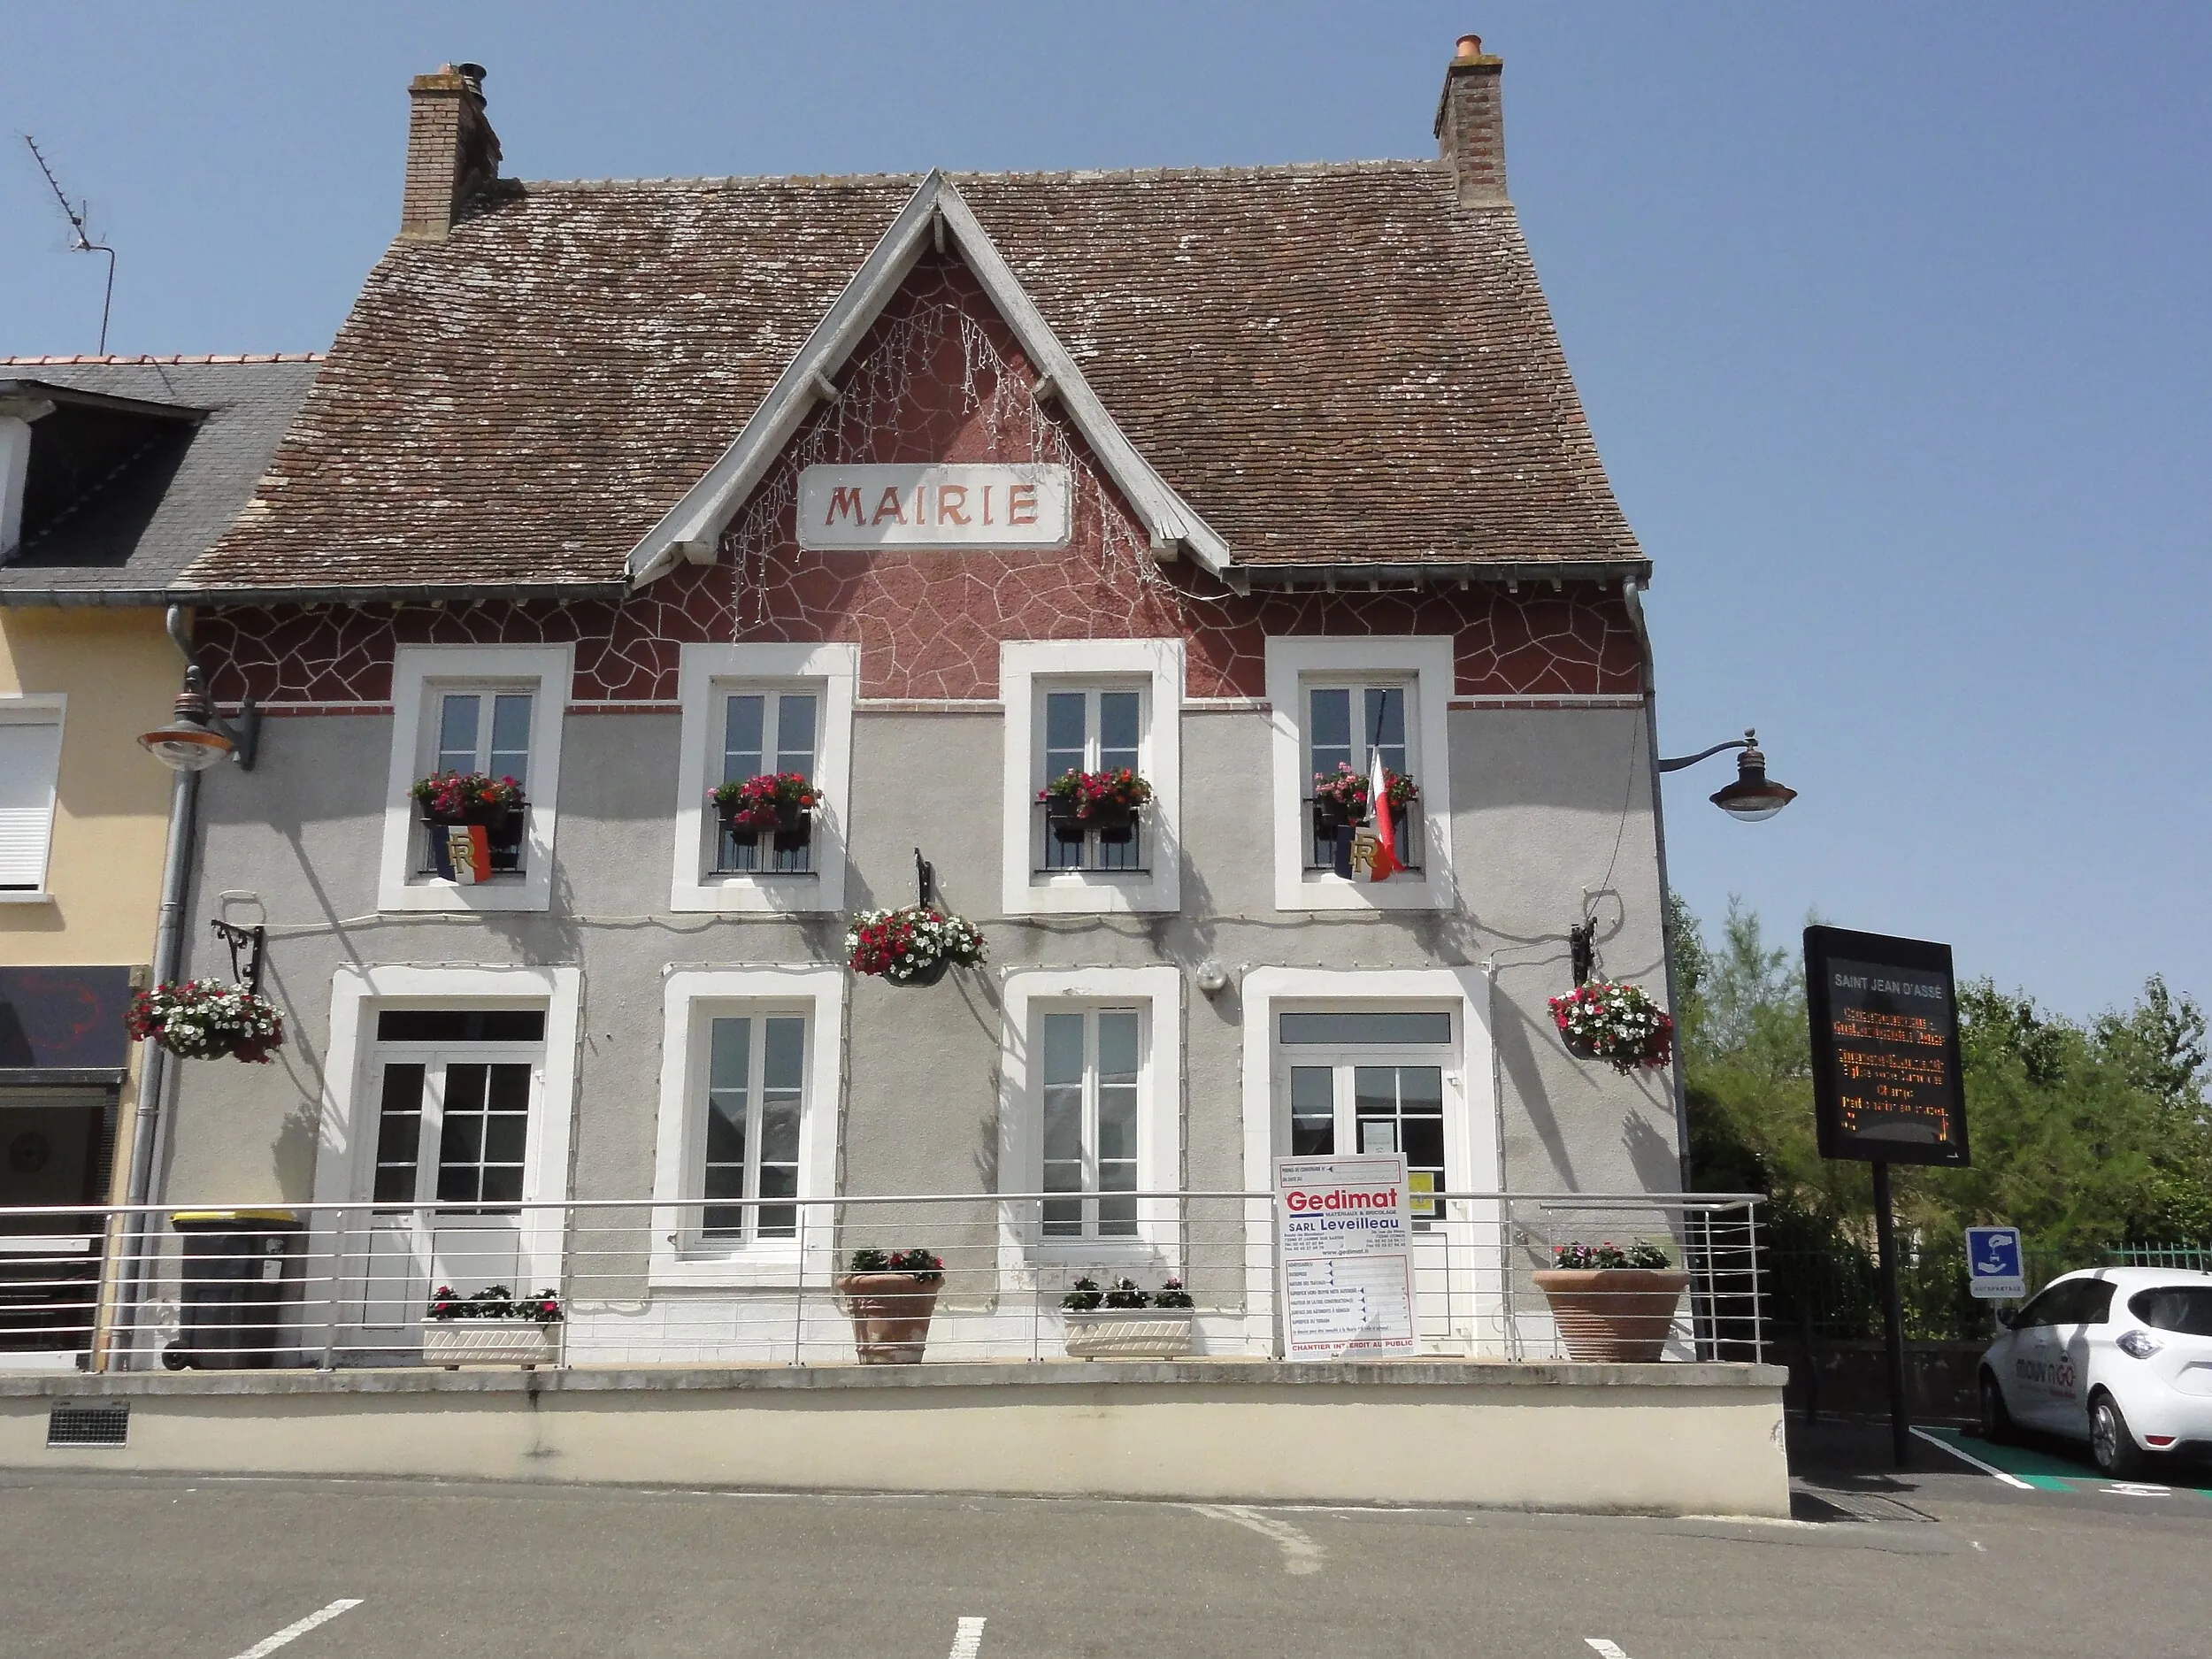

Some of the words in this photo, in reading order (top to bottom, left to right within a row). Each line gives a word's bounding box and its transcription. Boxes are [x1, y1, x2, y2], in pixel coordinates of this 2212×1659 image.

[824, 485, 1039, 526] MAIRIE
[1834, 973, 1868, 990] SAINT
[1870, 979, 1901, 995] JEAN
[1902, 983, 1943, 999] D'ASSÉ
[1286, 1187, 1398, 1211] Gedimat
[1288, 1223, 1316, 1232] SARL
[1320, 1217, 1399, 1231] Leveilleau
